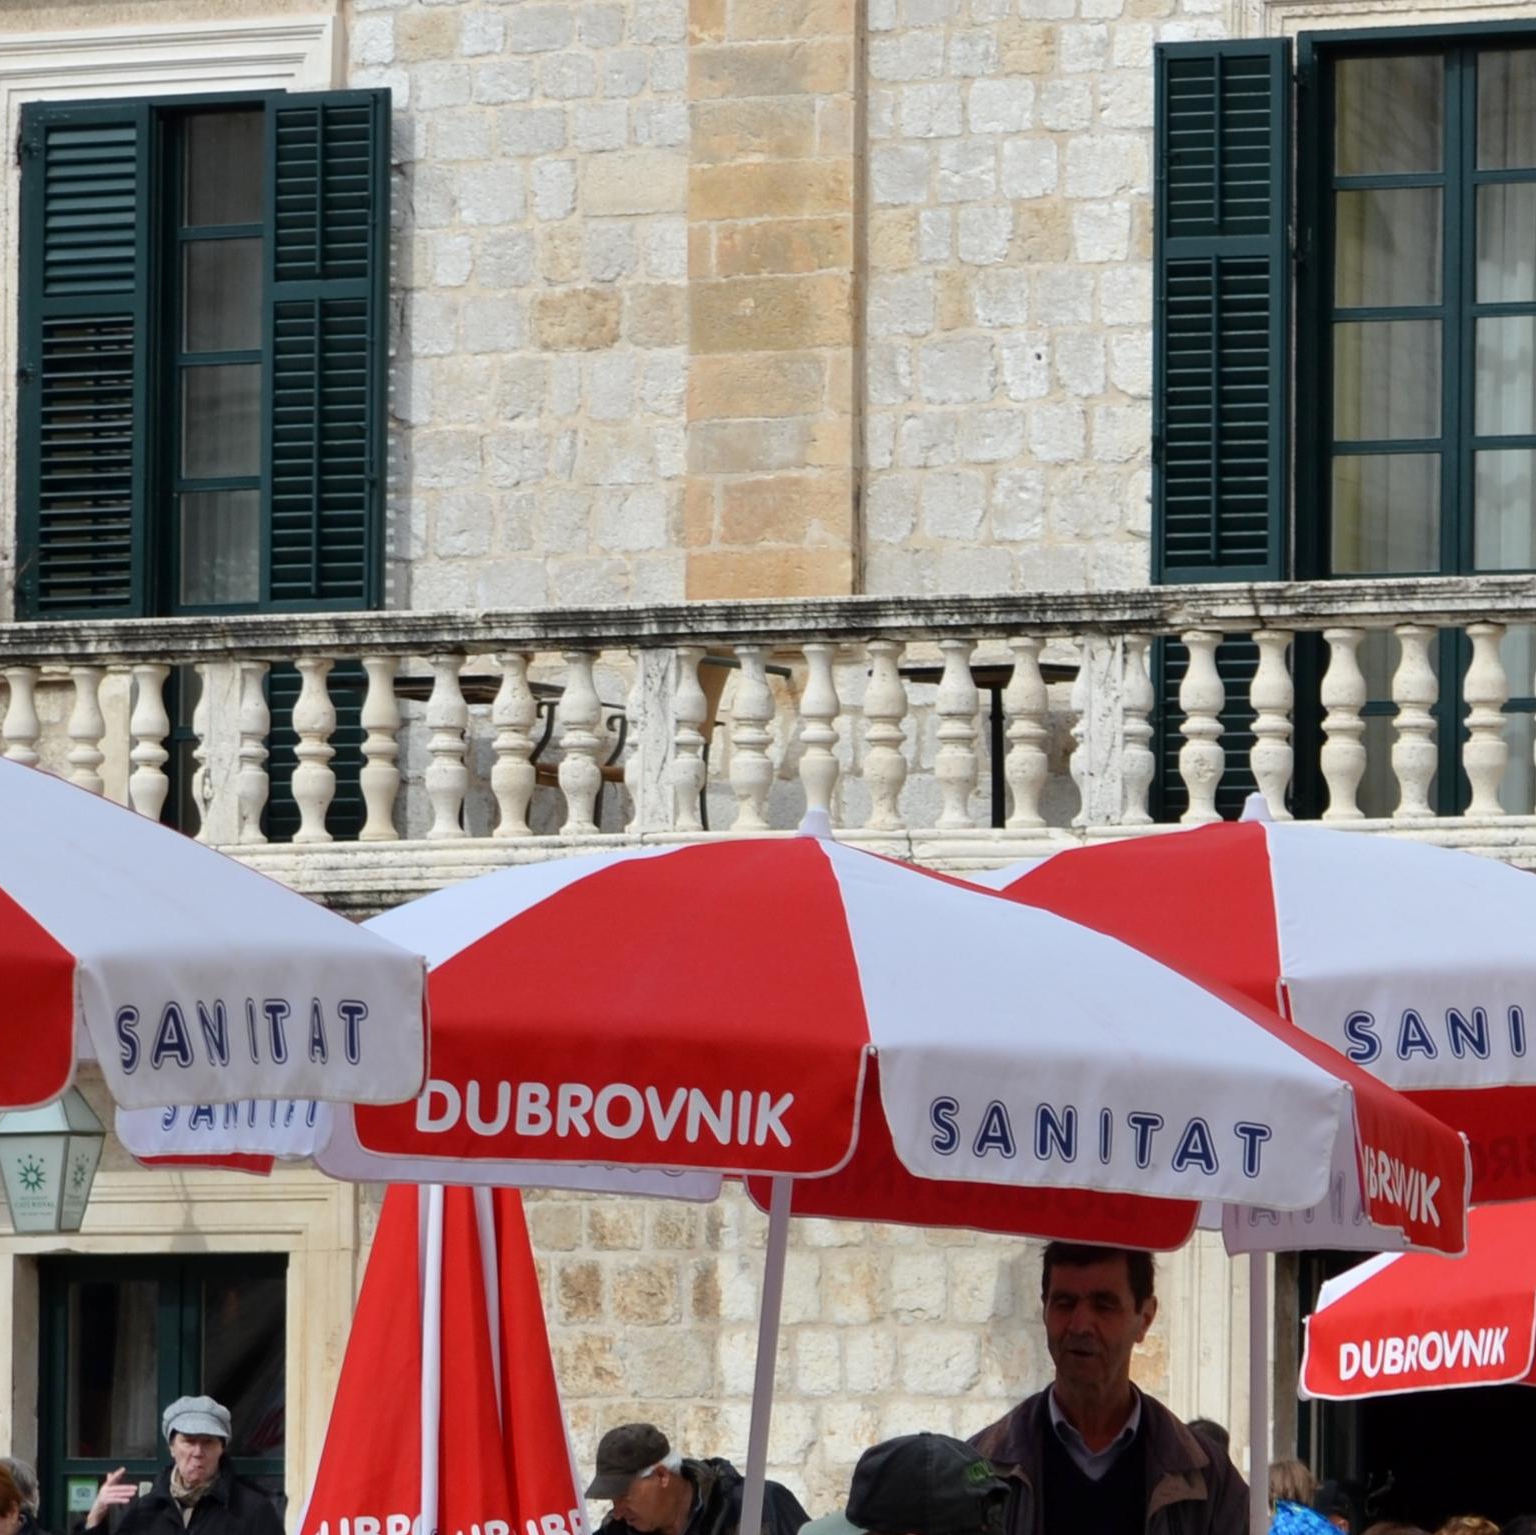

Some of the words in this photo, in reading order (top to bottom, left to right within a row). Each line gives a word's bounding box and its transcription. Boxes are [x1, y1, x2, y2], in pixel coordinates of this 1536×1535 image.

[117, 997, 369, 1075] SANITAT
[415, 1079, 795, 1148] DUBROVNIK
[930, 1096, 1273, 1179] SANITAT
[1339, 1326, 1509, 1381] DUBROVNIK
